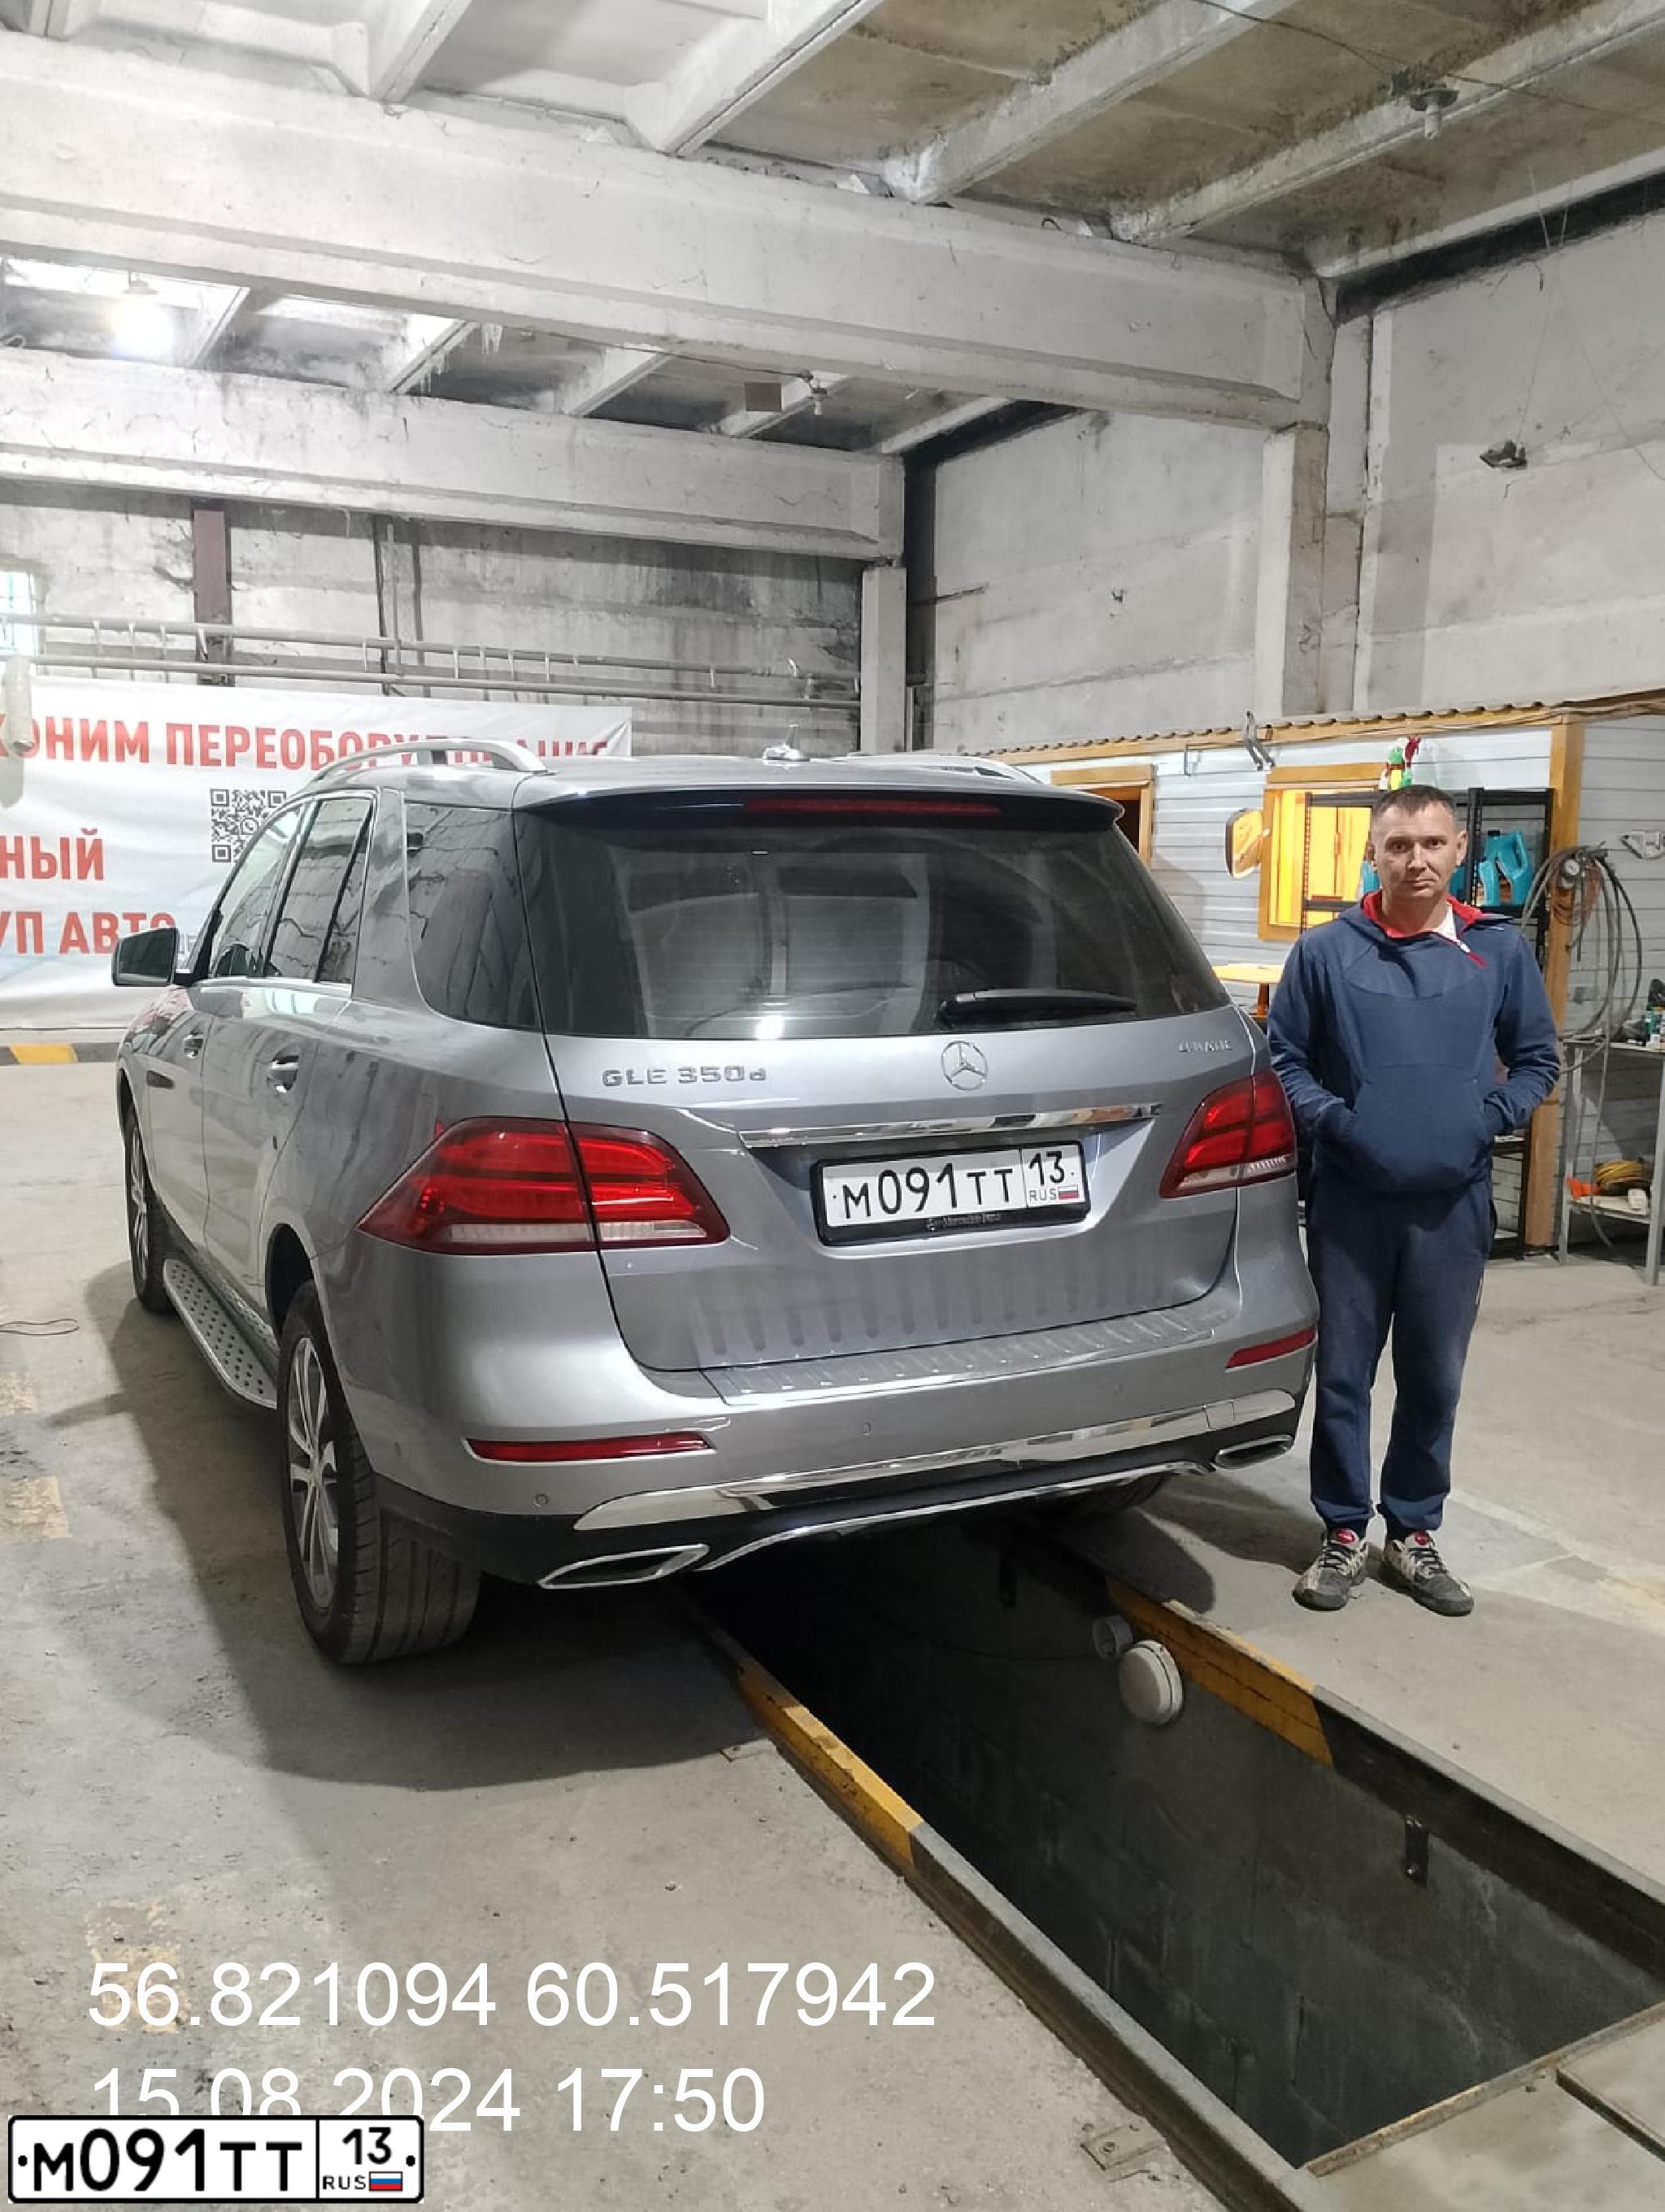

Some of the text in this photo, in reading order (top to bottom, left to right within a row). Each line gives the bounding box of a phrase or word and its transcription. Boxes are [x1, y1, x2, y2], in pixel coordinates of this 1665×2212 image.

[0, 828, 104, 881] НЫЙ
[602, 1065, 767, 1087] GLE 350d
[842, 1151, 1065, 1219] М091ТТ 13
[1029, 1186, 1057, 1202] RUS
